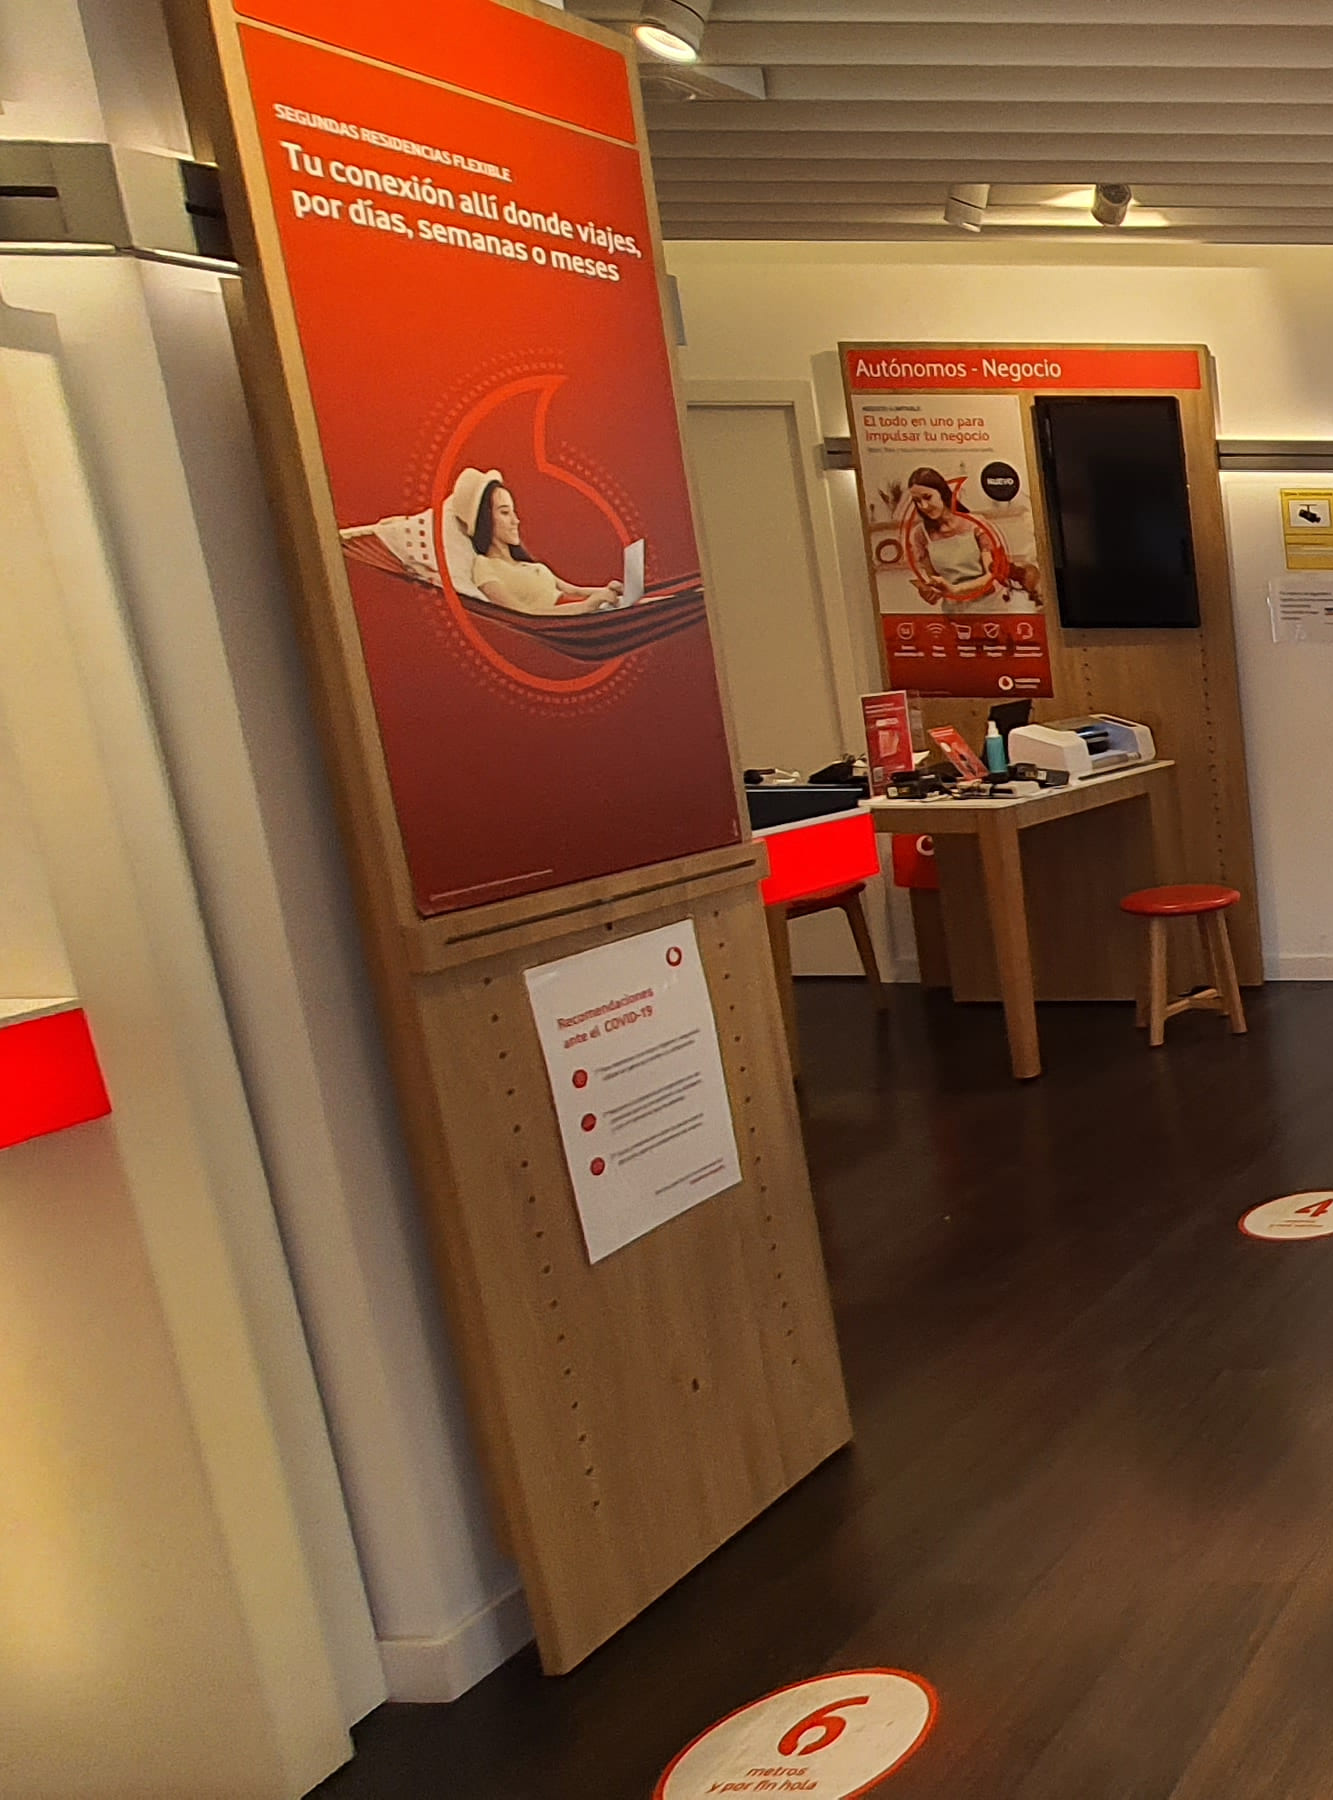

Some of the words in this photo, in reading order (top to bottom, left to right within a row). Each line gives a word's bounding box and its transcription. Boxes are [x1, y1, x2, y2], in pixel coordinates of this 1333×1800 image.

[273, 103, 359, 140] SEGUNDAS
[360, 128, 452, 165] RESIDENCIAS
[452, 154, 513, 183] FLEXIBLE
[280, 140, 325, 177] Tu
[330, 161, 455, 209] conexión
[459, 191, 499, 220] allí
[503, 201, 574, 239] donde
[576, 221, 642, 258] viajes,
[291, 190, 343, 219] por
[349, 198, 414, 239] días,
[417, 219, 528, 262] semanas
[532, 246, 546, 265] o
[551, 250, 620, 281] meses
[856, 359, 967, 378] Autónomos
[982, 359, 1062, 382] Negocio
[863, 415, 875, 427] El
[879, 416, 908, 427] todo
[911, 417, 926, 427] en
[930, 416, 954, 427] uno
[957, 416, 985, 430] para
[924, 431, 937, 441] tu
[941, 430, 990, 444] negocio
[557, 988, 654, 1028] Recomendaciones
[604, 1005, 652, 1032] COVID-19
[778, 1696, 870, 1757] 6
[745, 1766, 808, 1777] metros
[705, 1782, 722, 1794] y
[719, 1782, 754, 1794] por
[753, 1780, 779, 1792] fin
[779, 1779, 819, 1792] hola
